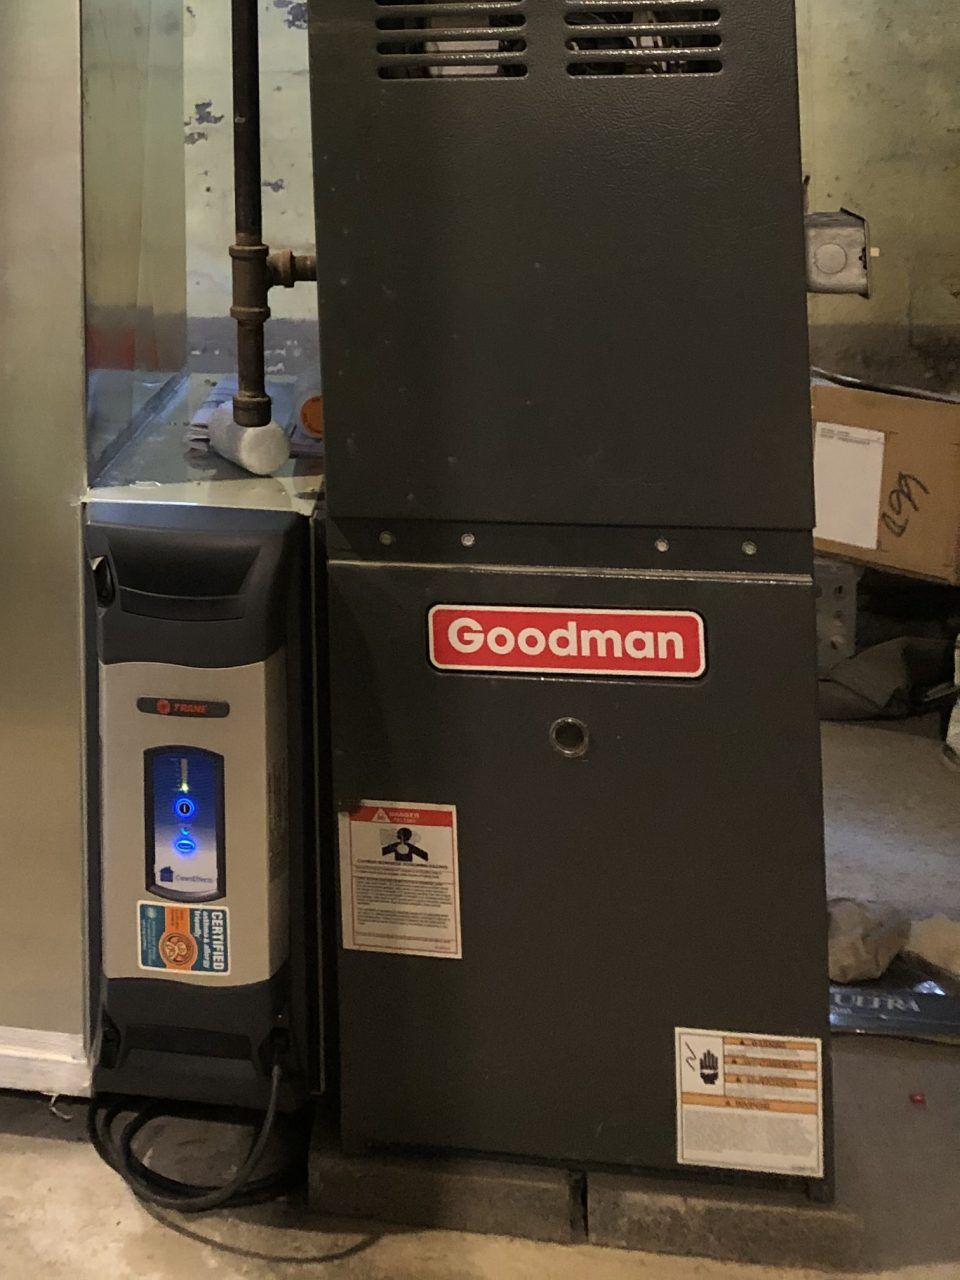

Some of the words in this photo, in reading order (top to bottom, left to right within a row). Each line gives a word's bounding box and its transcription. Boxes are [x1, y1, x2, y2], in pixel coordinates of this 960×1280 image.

[447, 617, 685, 659] Goodman
[174, 703, 209, 713] TRANE
[194, 910, 202, 938] friendly
[202, 910, 210, 938] asthma
[211, 911, 224, 970] CERTIFIED
[202, 944, 211, 968] allergy
